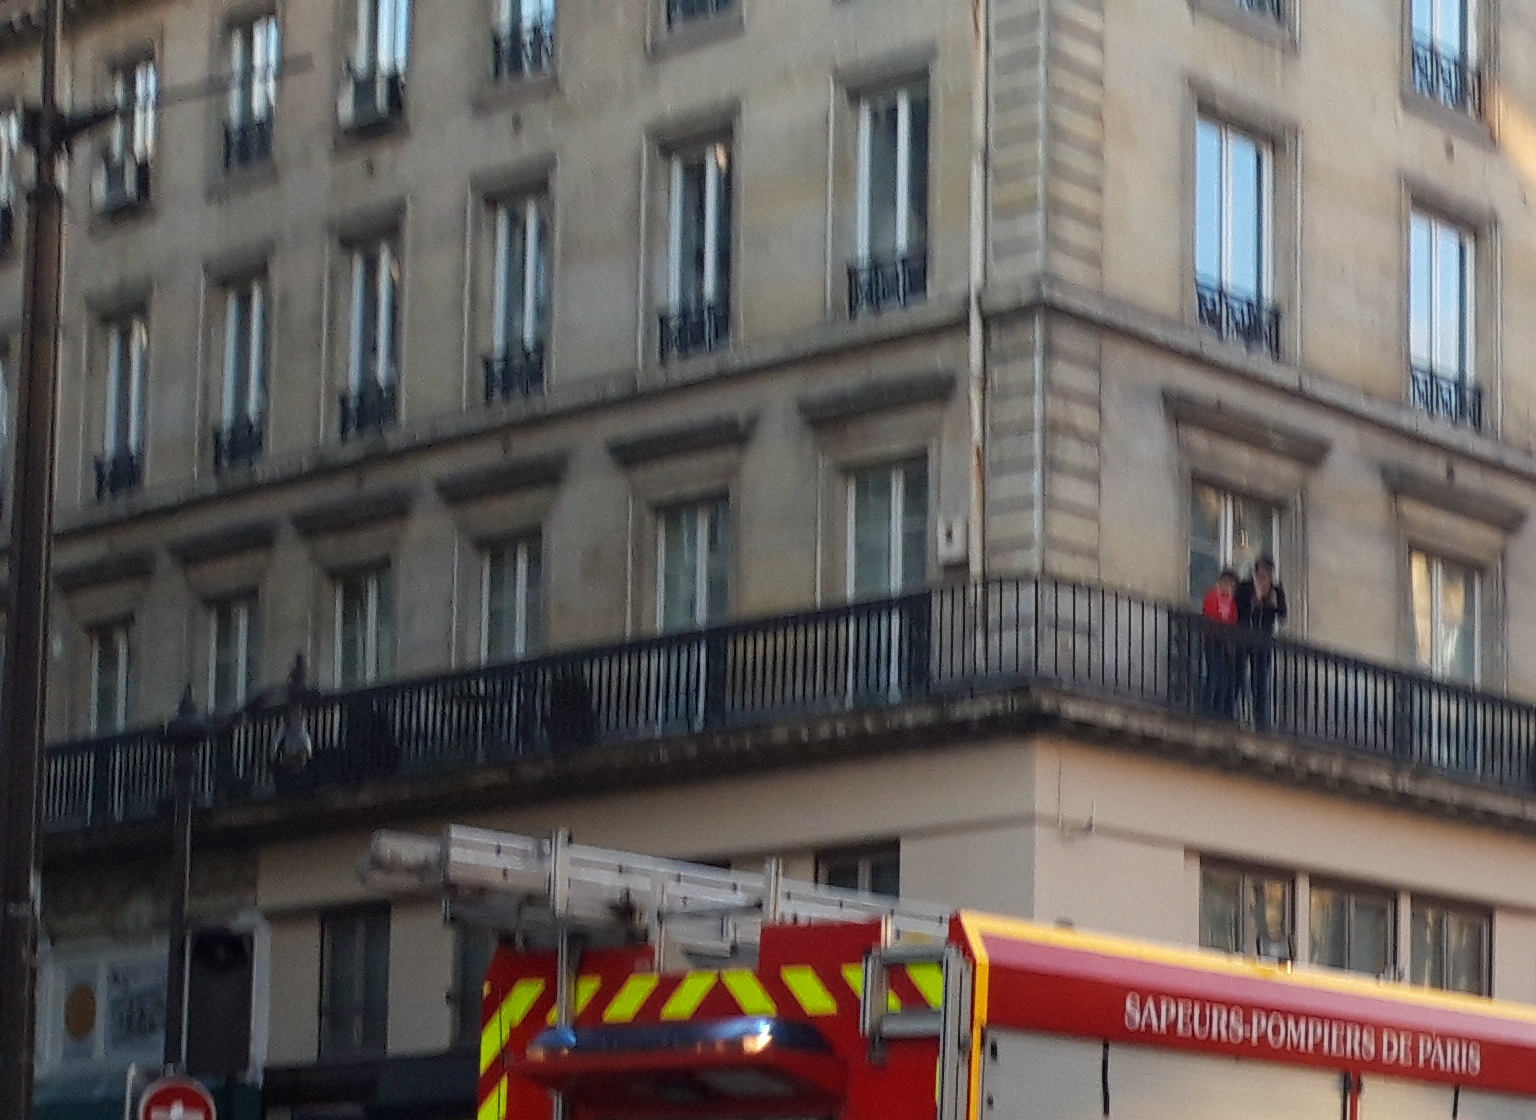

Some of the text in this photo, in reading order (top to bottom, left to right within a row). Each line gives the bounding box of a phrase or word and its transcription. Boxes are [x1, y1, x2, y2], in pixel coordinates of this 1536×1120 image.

[1124, 991, 1481, 1077] SAPEURS-POMPIERS DE PARIS
